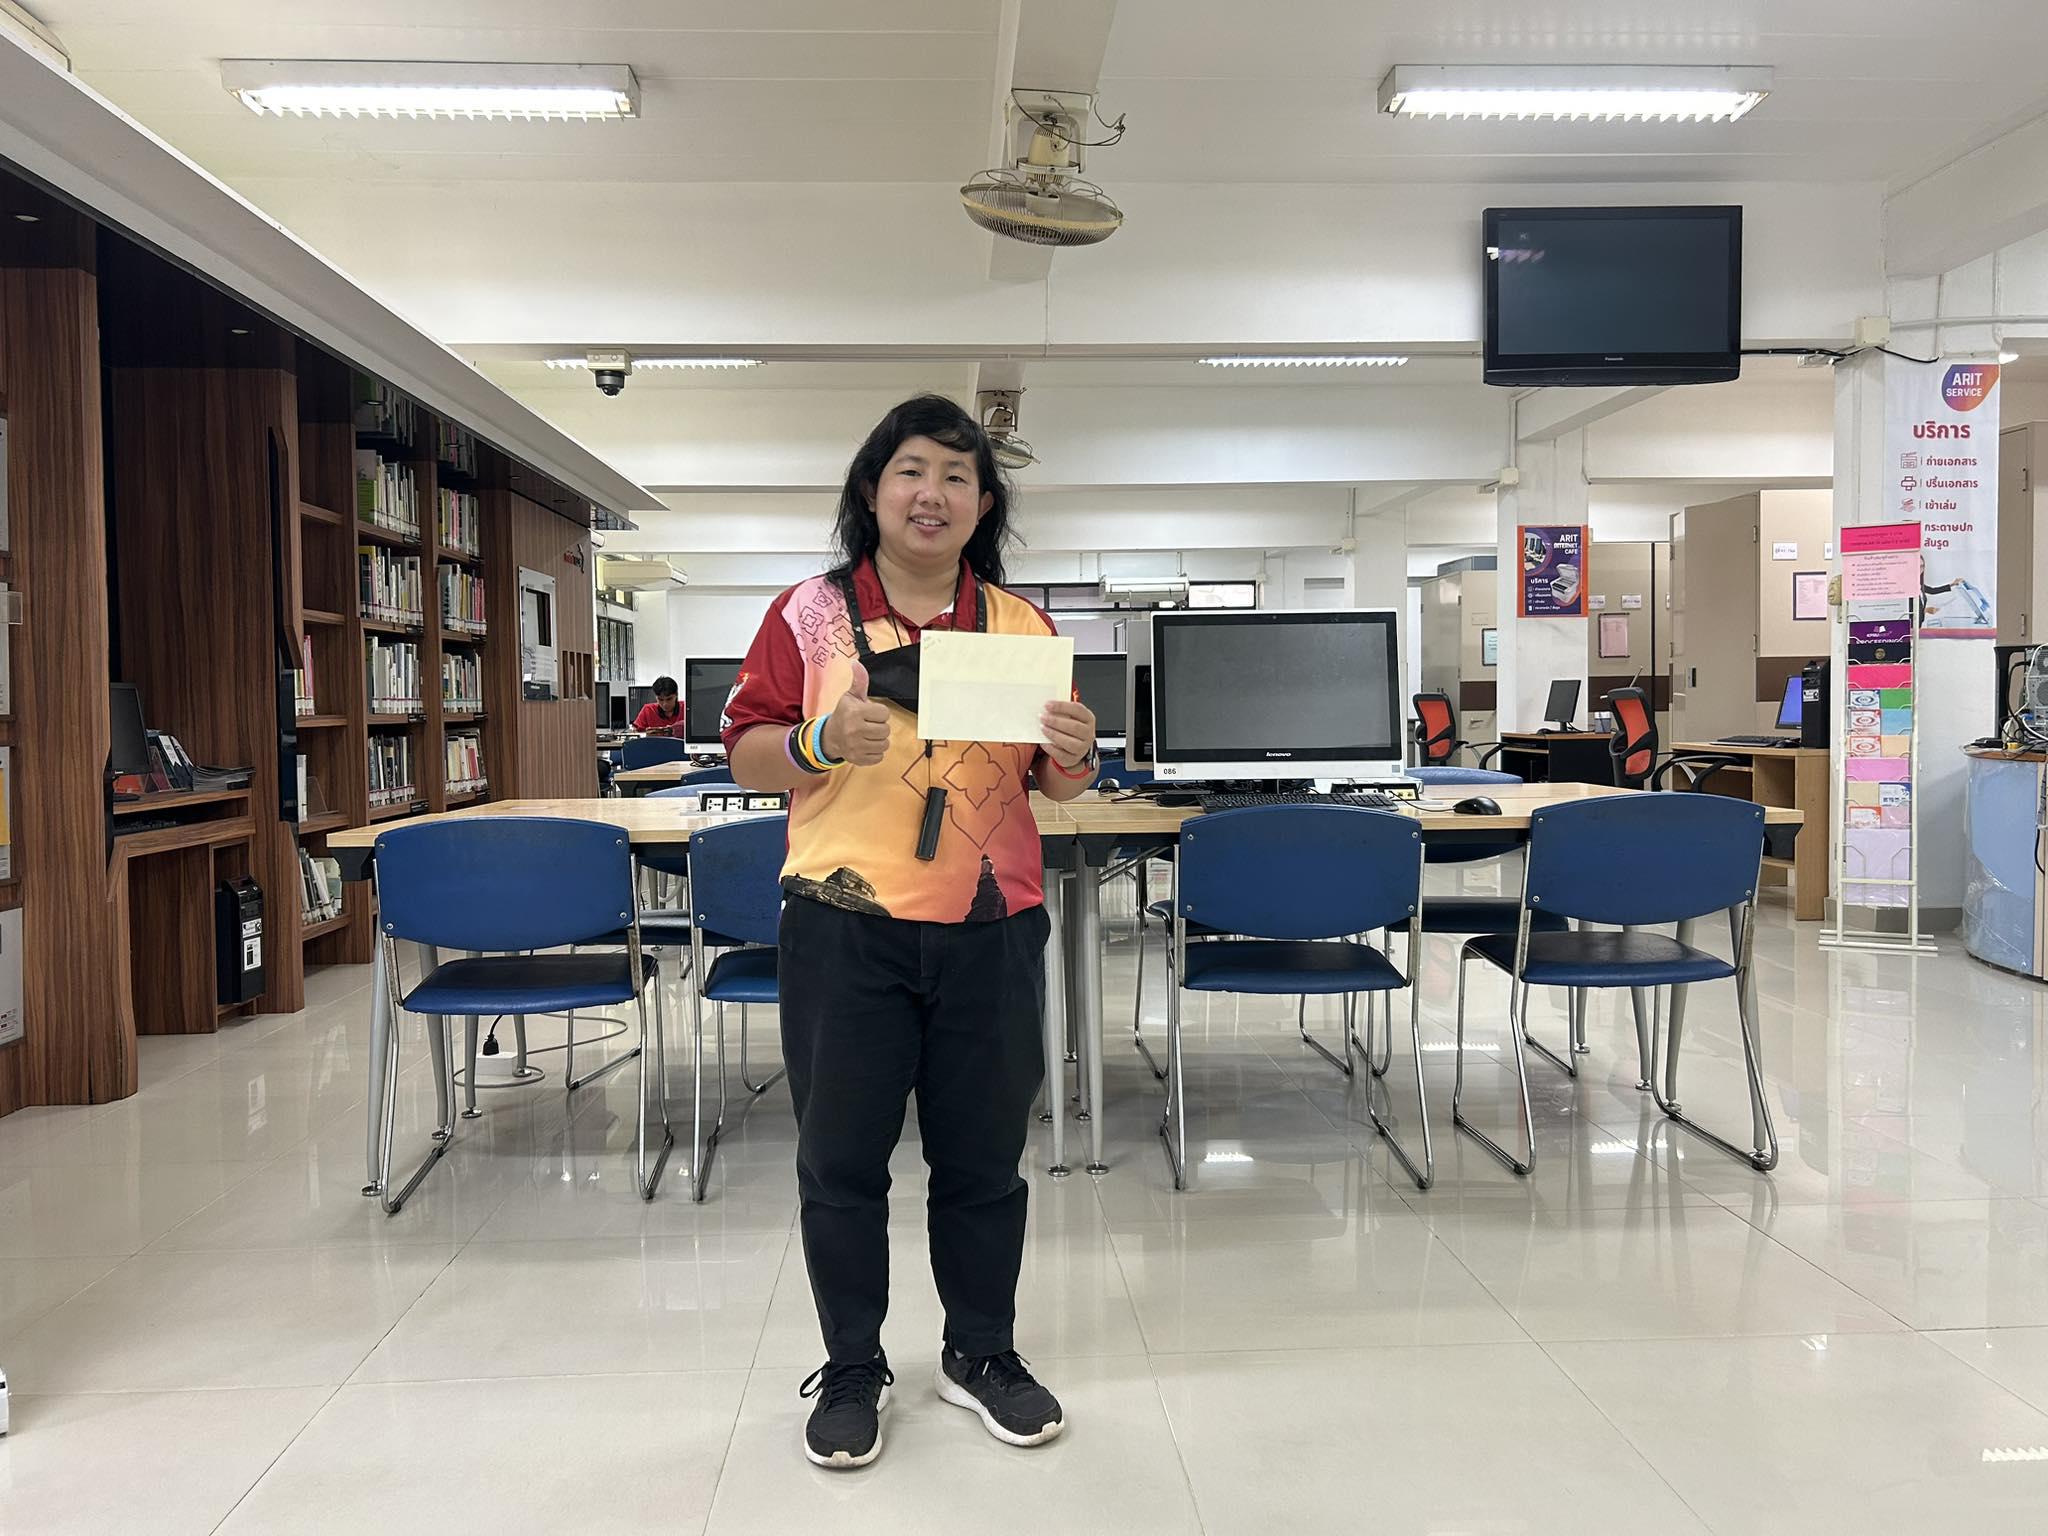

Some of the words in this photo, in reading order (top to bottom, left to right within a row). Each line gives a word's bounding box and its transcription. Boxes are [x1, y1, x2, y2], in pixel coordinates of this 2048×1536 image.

[1952, 372, 1983, 386] ARIT
[1945, 387, 1983, 397] SERVICE
[1913, 420, 1970, 439] บริการ
[1926, 455, 1978, 466] ถ่ายเอกสาร
[1925, 498, 1957, 510] เข้าเล่ม
[1924, 522, 1974, 532] กระดาษปก
[1559, 534, 1578, 542] ARIT
